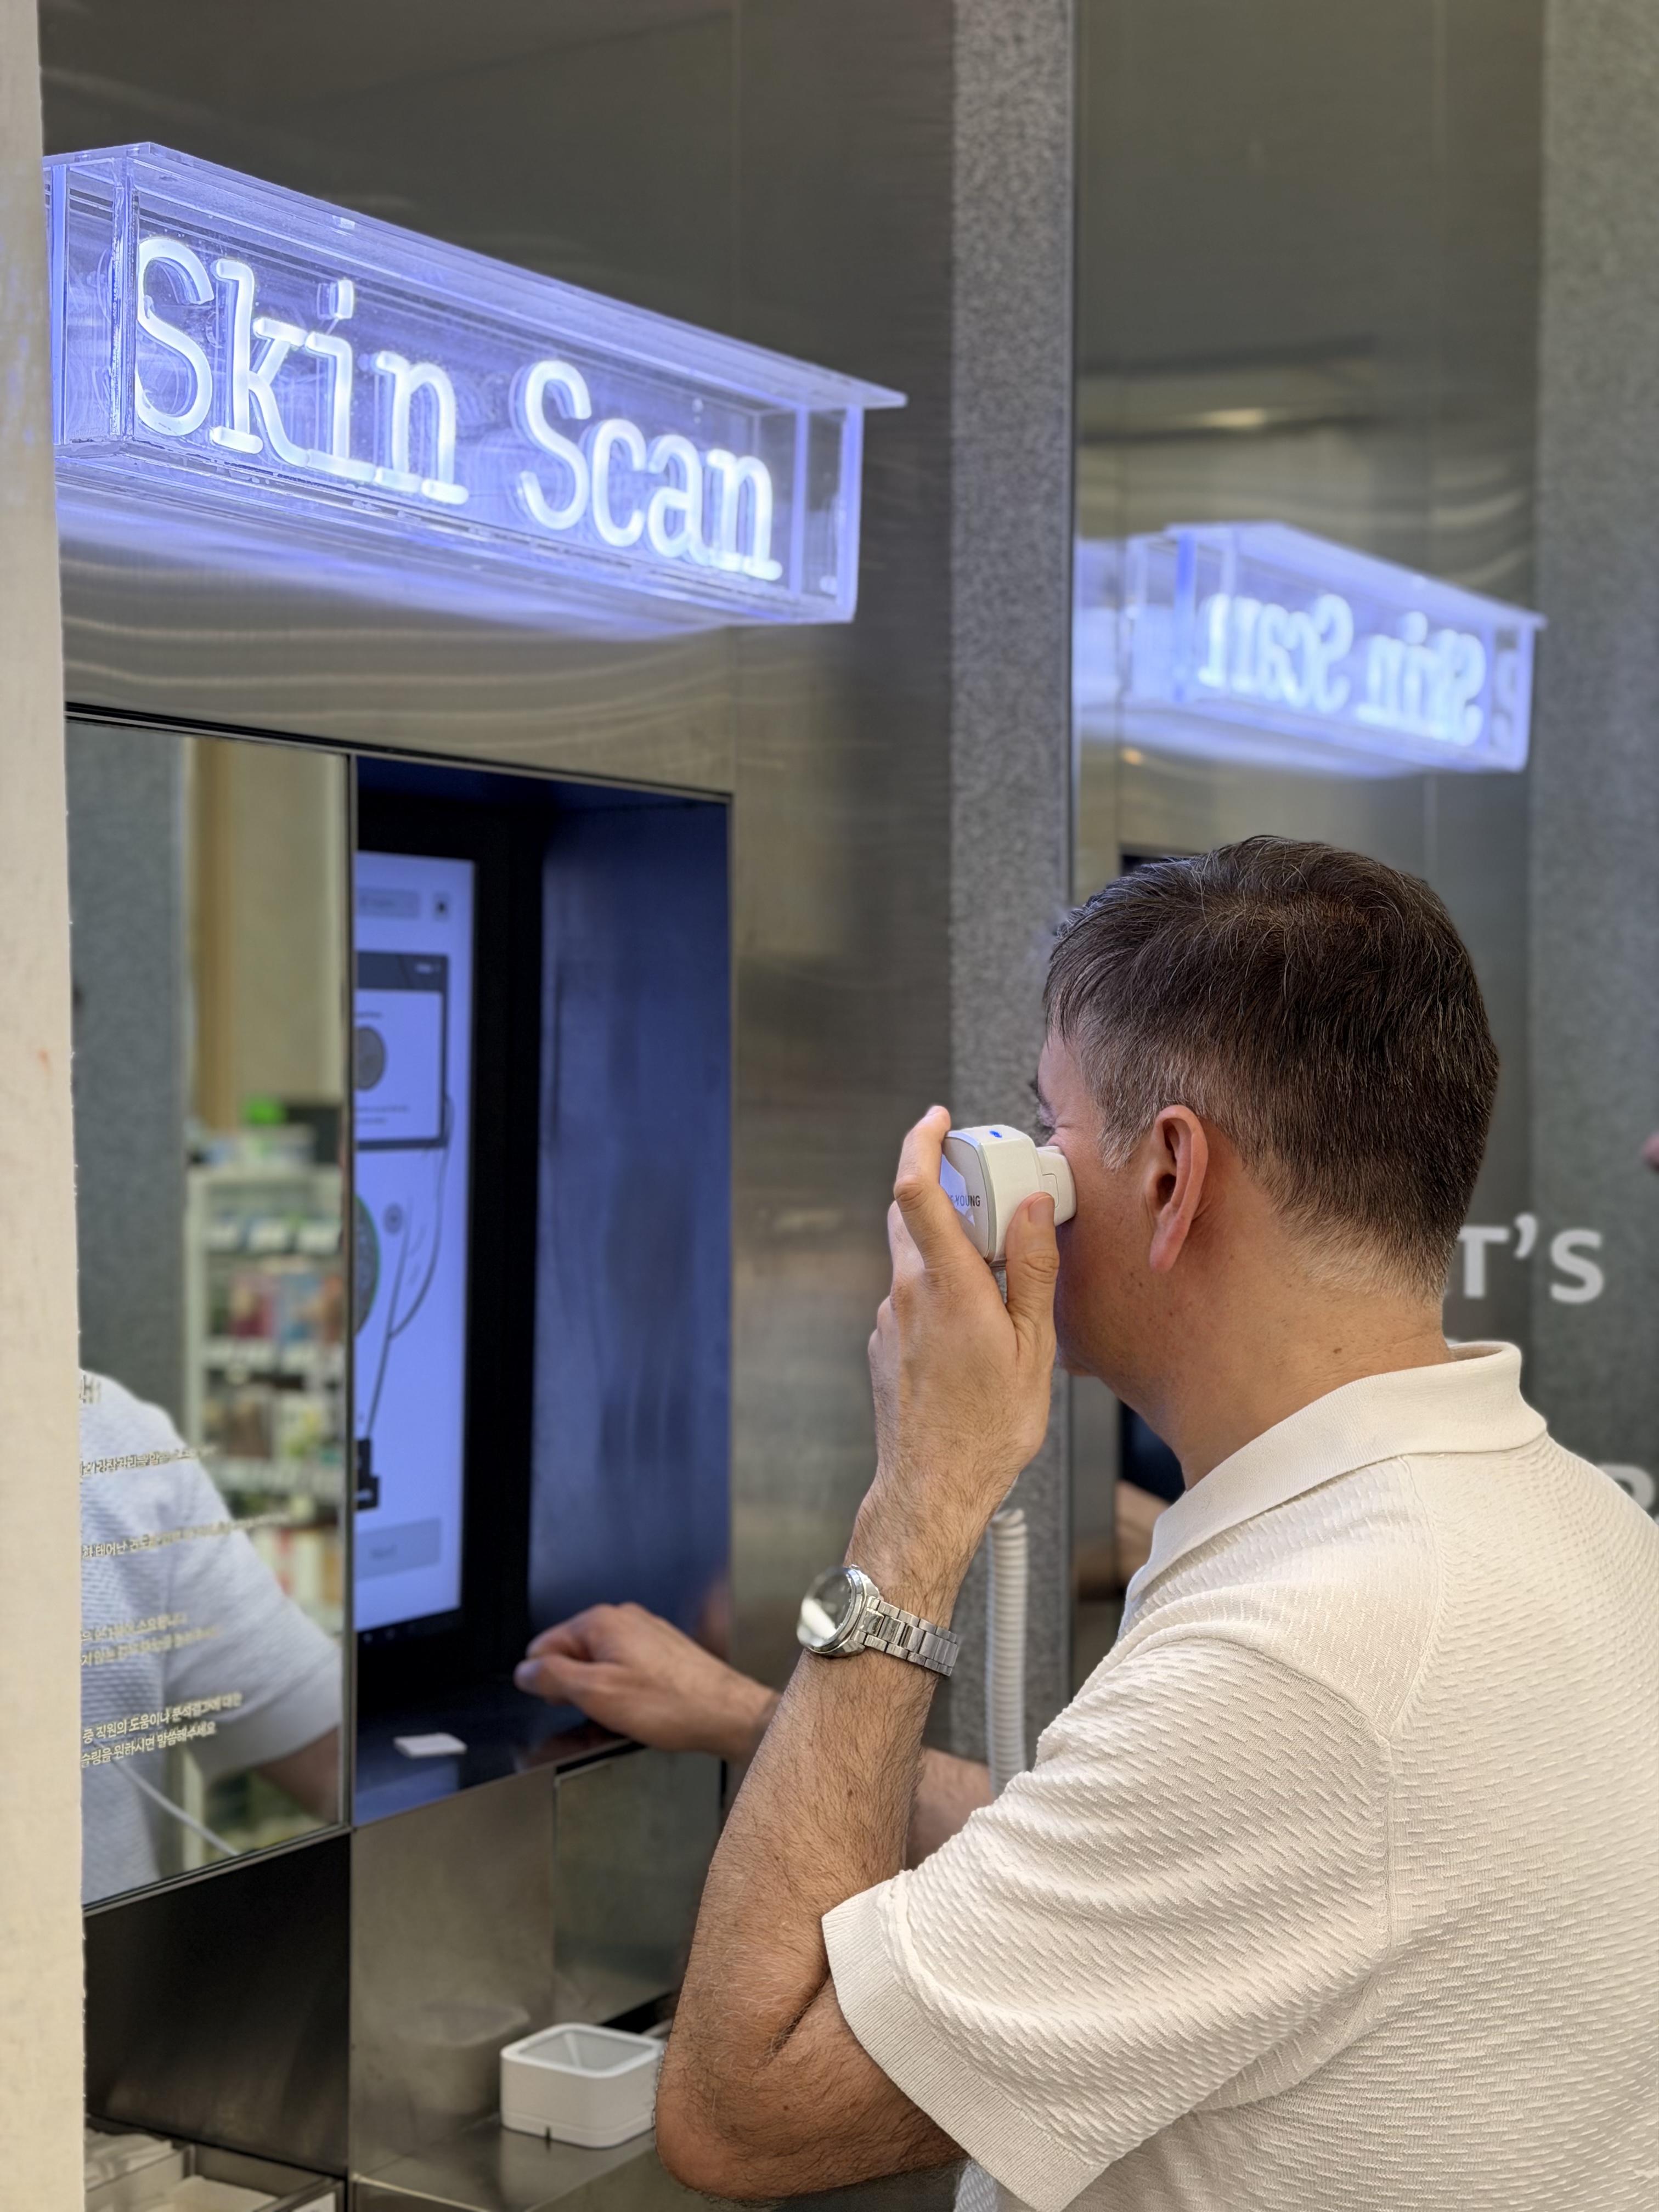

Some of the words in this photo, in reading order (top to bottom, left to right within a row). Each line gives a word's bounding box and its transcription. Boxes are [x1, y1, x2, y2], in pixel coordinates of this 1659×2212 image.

[137, 238, 469, 504] Skin
[520, 360, 783, 580] Scan
[955, 1195, 981, 1207] YOUNG
[1448, 1214, 1604, 1304] T'S
[96, 1720, 127, 1739] 직원의
[128, 1712, 170, 1732] 도움이나
[114, 1736, 155, 1759] 원하시면
